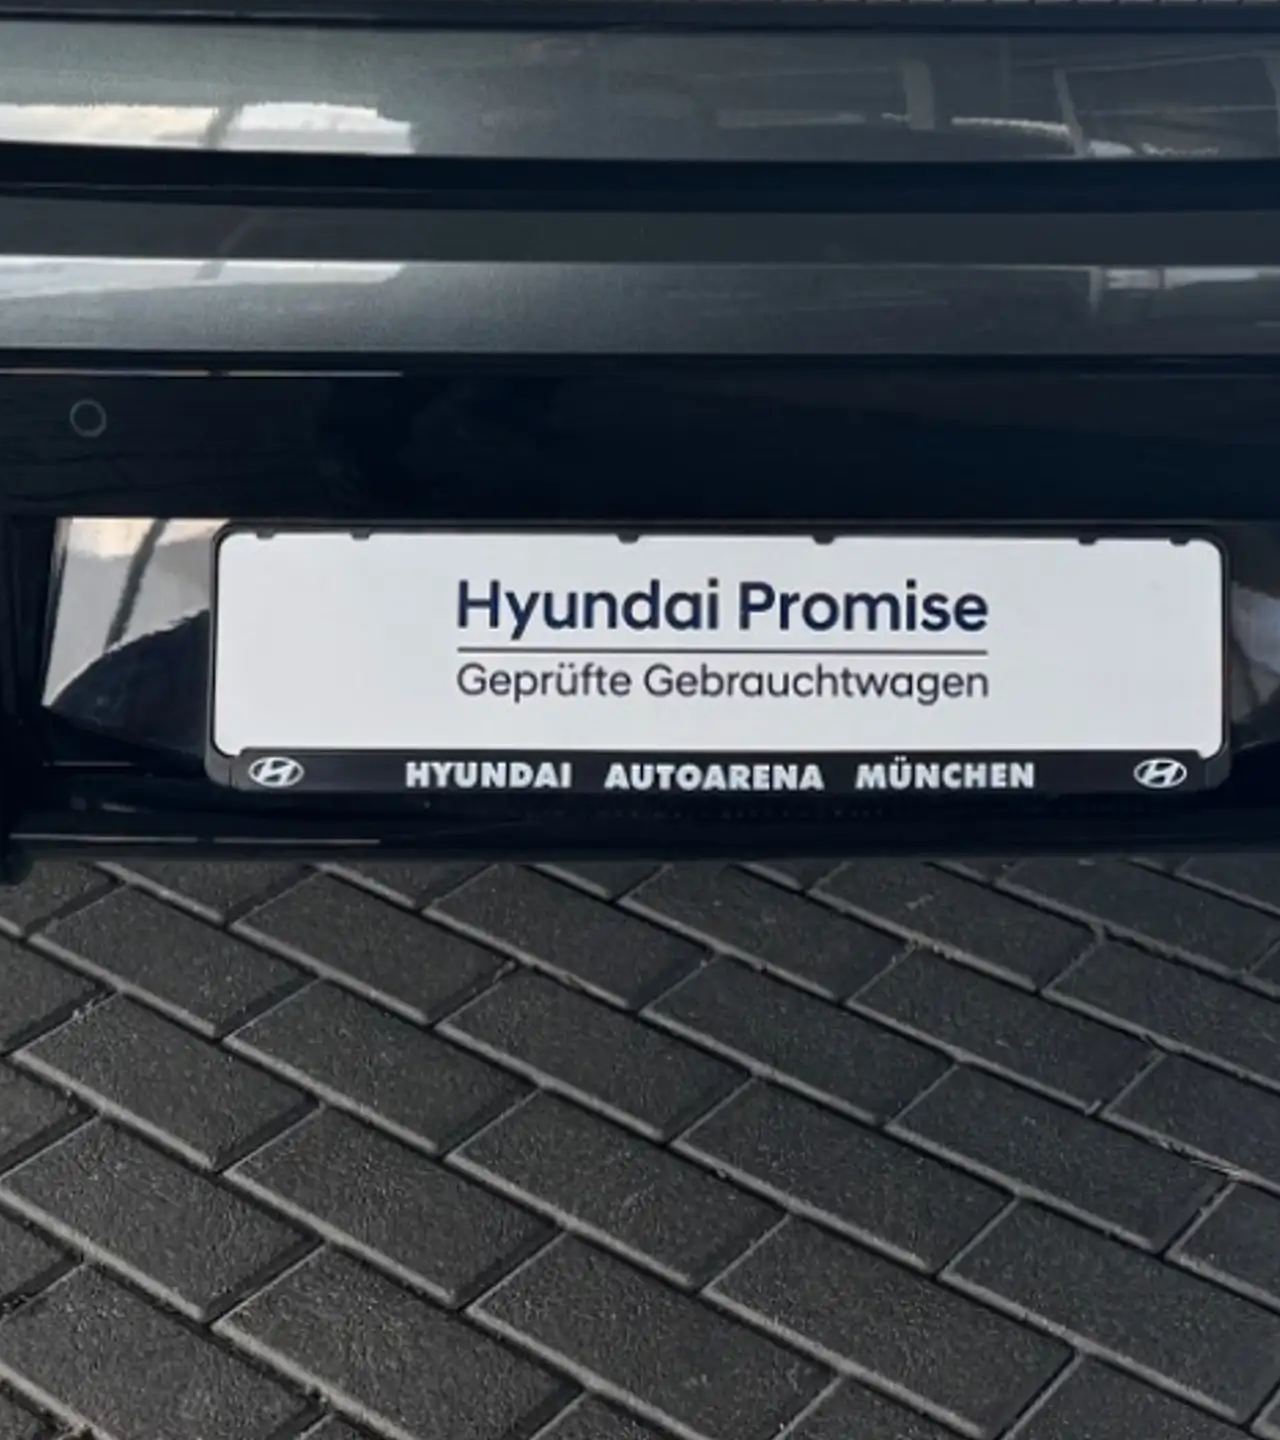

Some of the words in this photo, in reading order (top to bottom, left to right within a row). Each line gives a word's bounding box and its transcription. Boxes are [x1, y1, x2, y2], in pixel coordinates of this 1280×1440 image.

[456, 577, 720, 641] Hyundai
[738, 578, 989, 632] Promise
[456, 662, 633, 704] Geprüfte
[643, 663, 989, 706] Gebrauchtwagen
[405, 761, 572, 789] HYUNDAI
[604, 763, 825, 791] AUTOARENA
[855, 756, 1035, 790] MÜNCHEN
